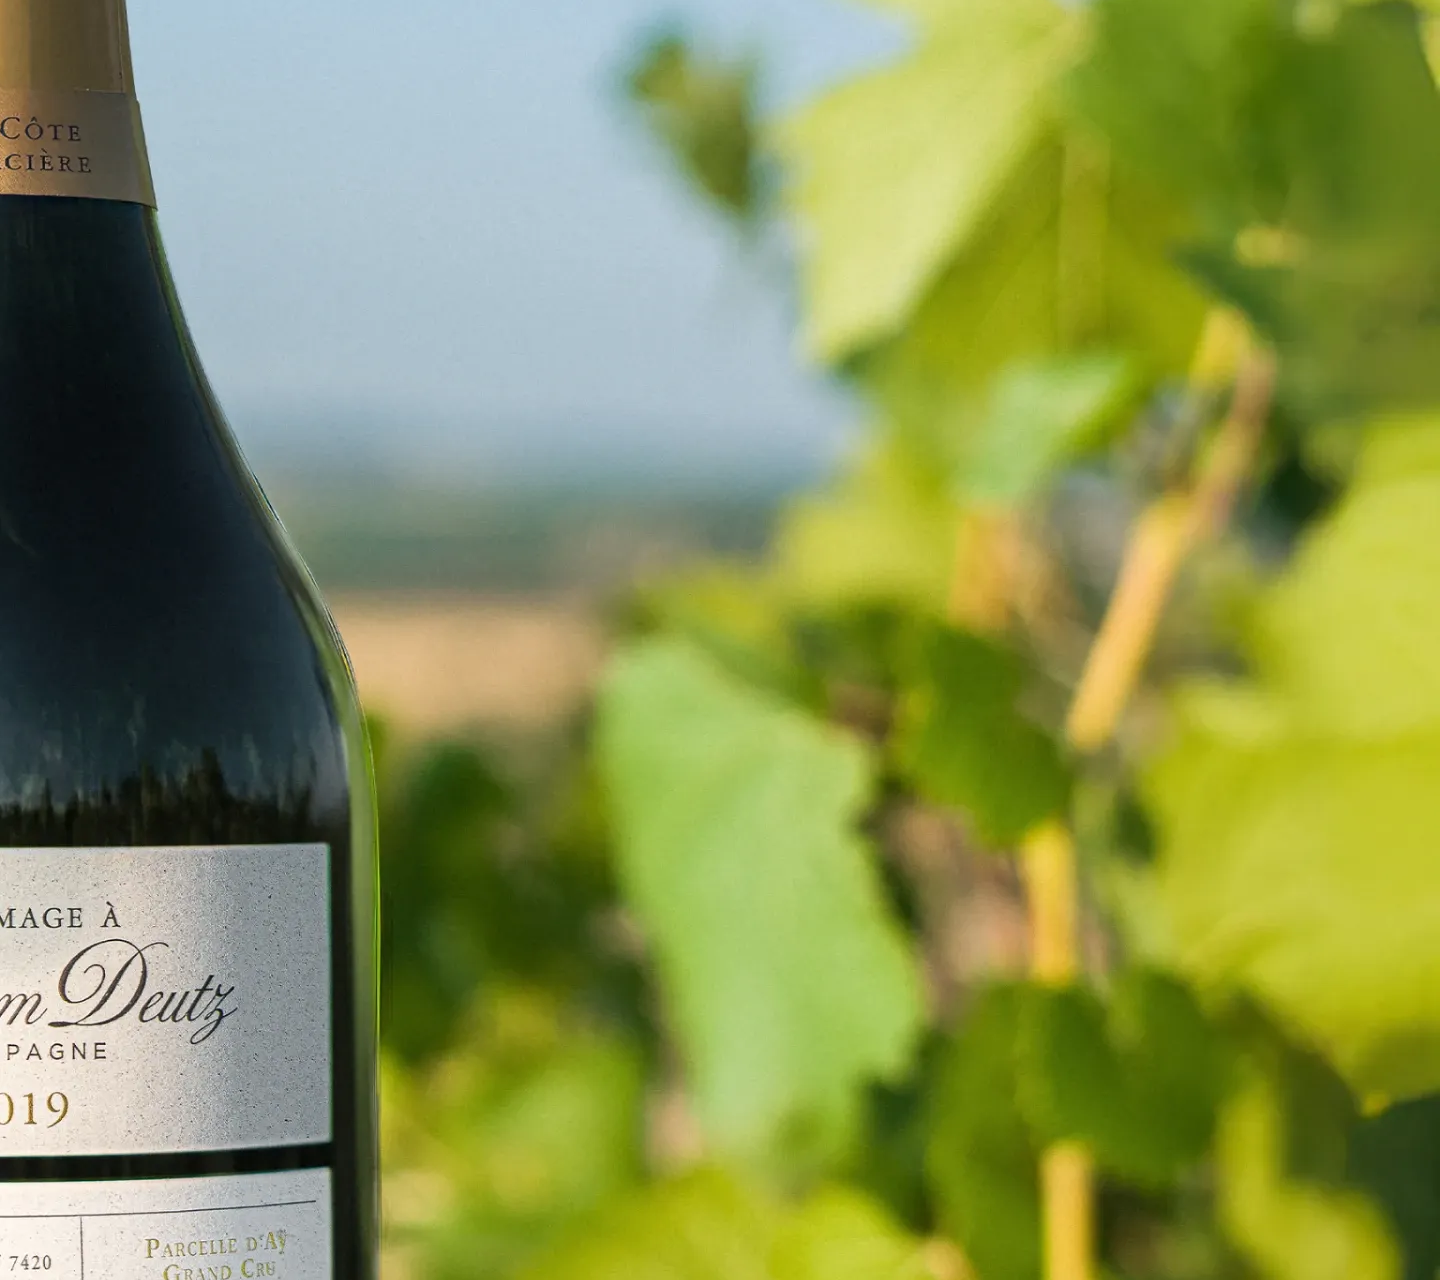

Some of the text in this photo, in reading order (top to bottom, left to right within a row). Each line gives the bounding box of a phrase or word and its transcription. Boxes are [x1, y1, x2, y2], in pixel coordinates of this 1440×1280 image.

[0, 116, 81, 142] CÔTE
[102, 900, 122, 929] À
[47, 938, 239, 1045] Deutz
[145, 1236, 238, 1259] PARCELLE
[9, 1255, 52, 1271] 7420
